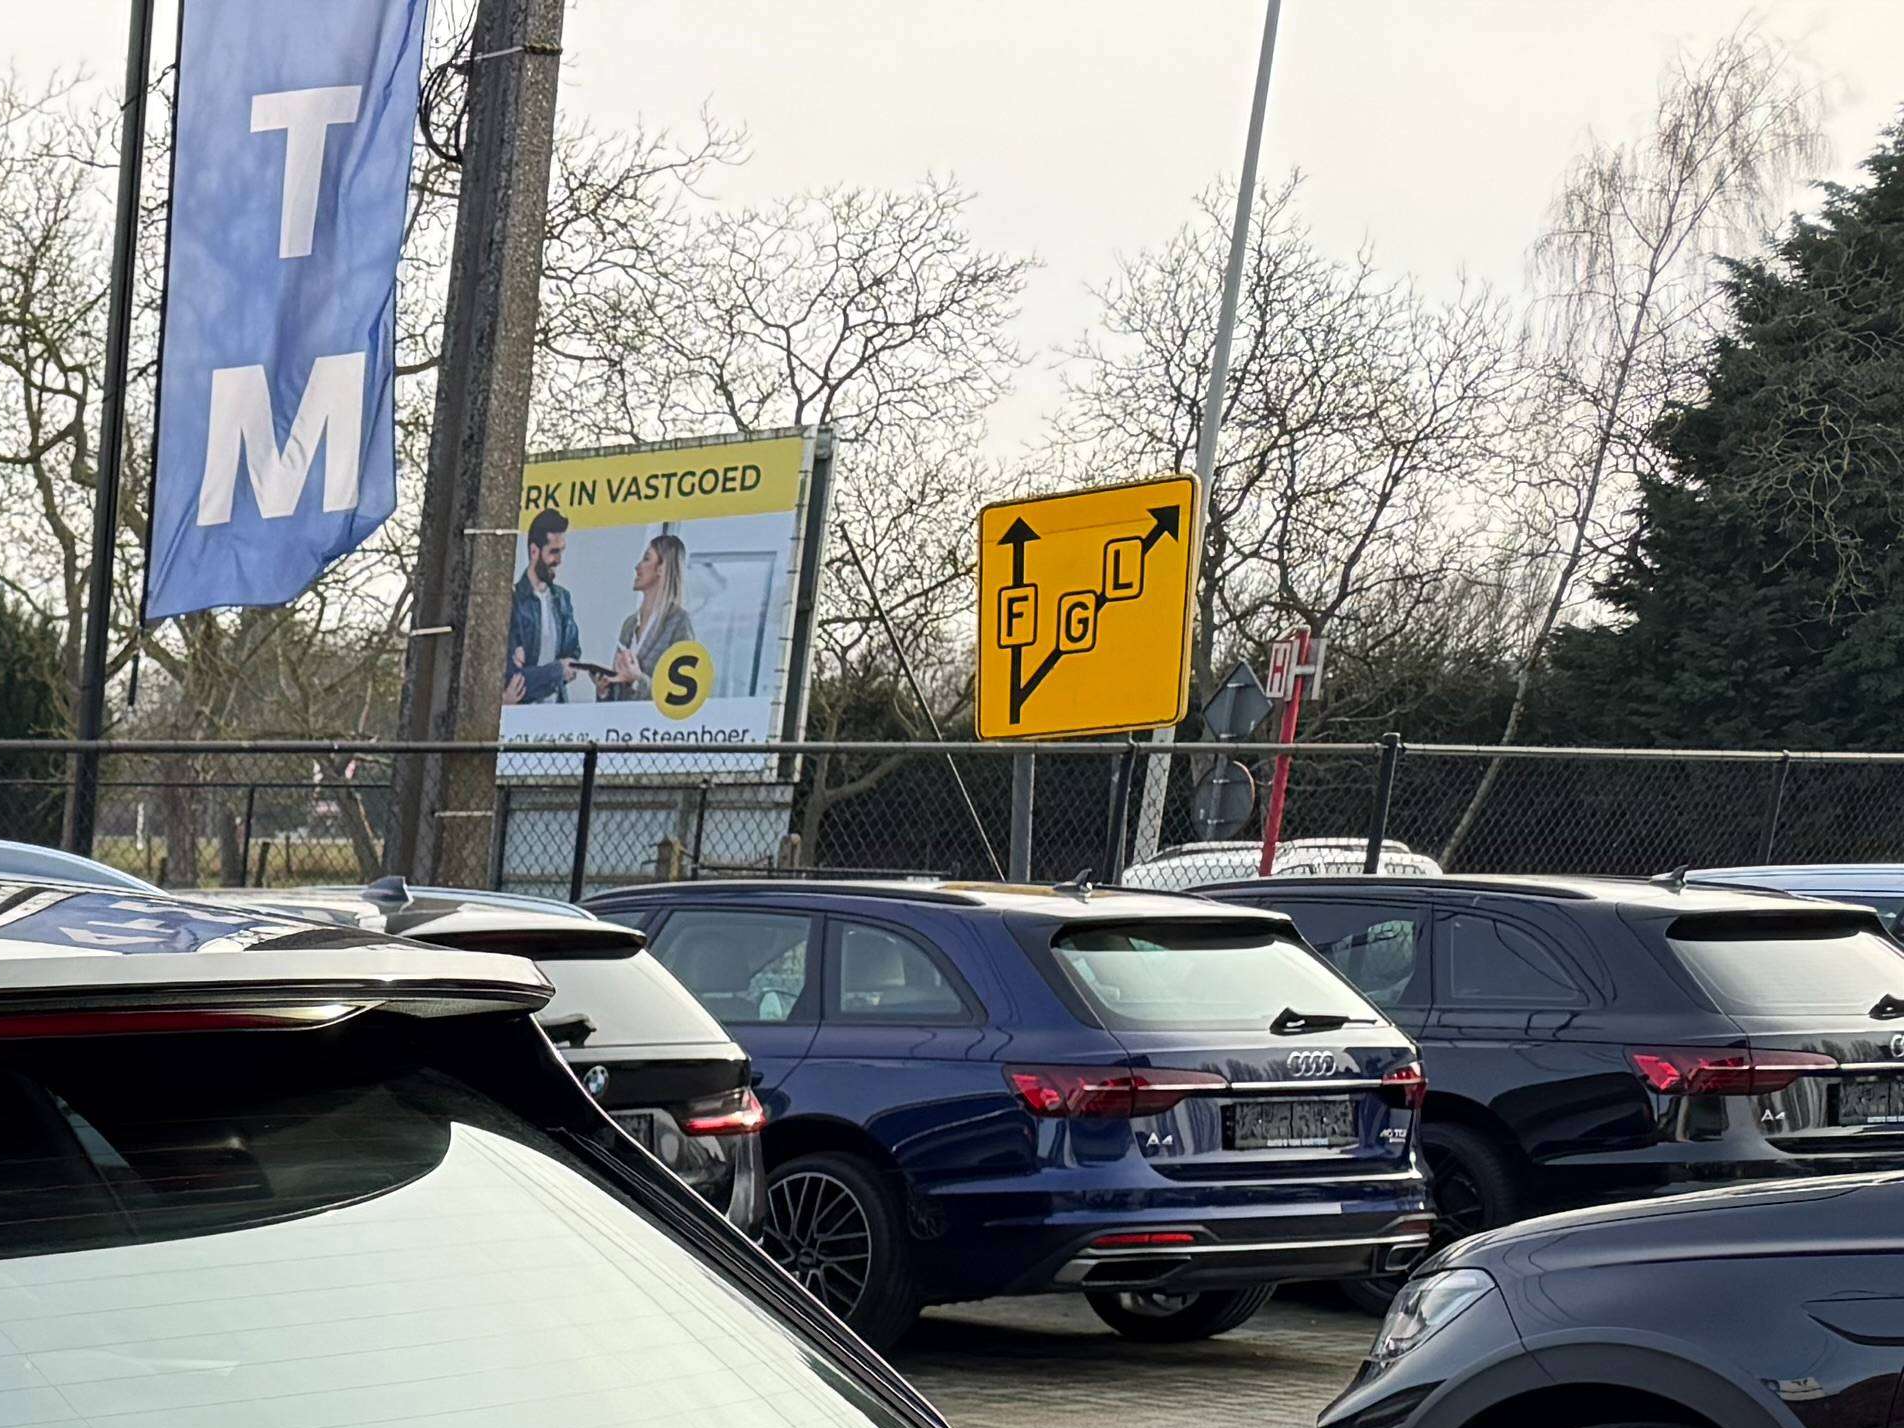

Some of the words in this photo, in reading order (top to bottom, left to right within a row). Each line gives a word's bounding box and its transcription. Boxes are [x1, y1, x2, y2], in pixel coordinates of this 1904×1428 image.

[249, 83, 363, 260] T
[196, 351, 366, 527] M
[521, 481, 563, 510] RK
[569, 479, 597, 507] IN
[606, 463, 762, 504] VASTGOED
[1112, 548, 1134, 591] L
[1006, 594, 1030, 638] F
[1064, 601, 1090, 643] G
[664, 654, 700, 706] S
